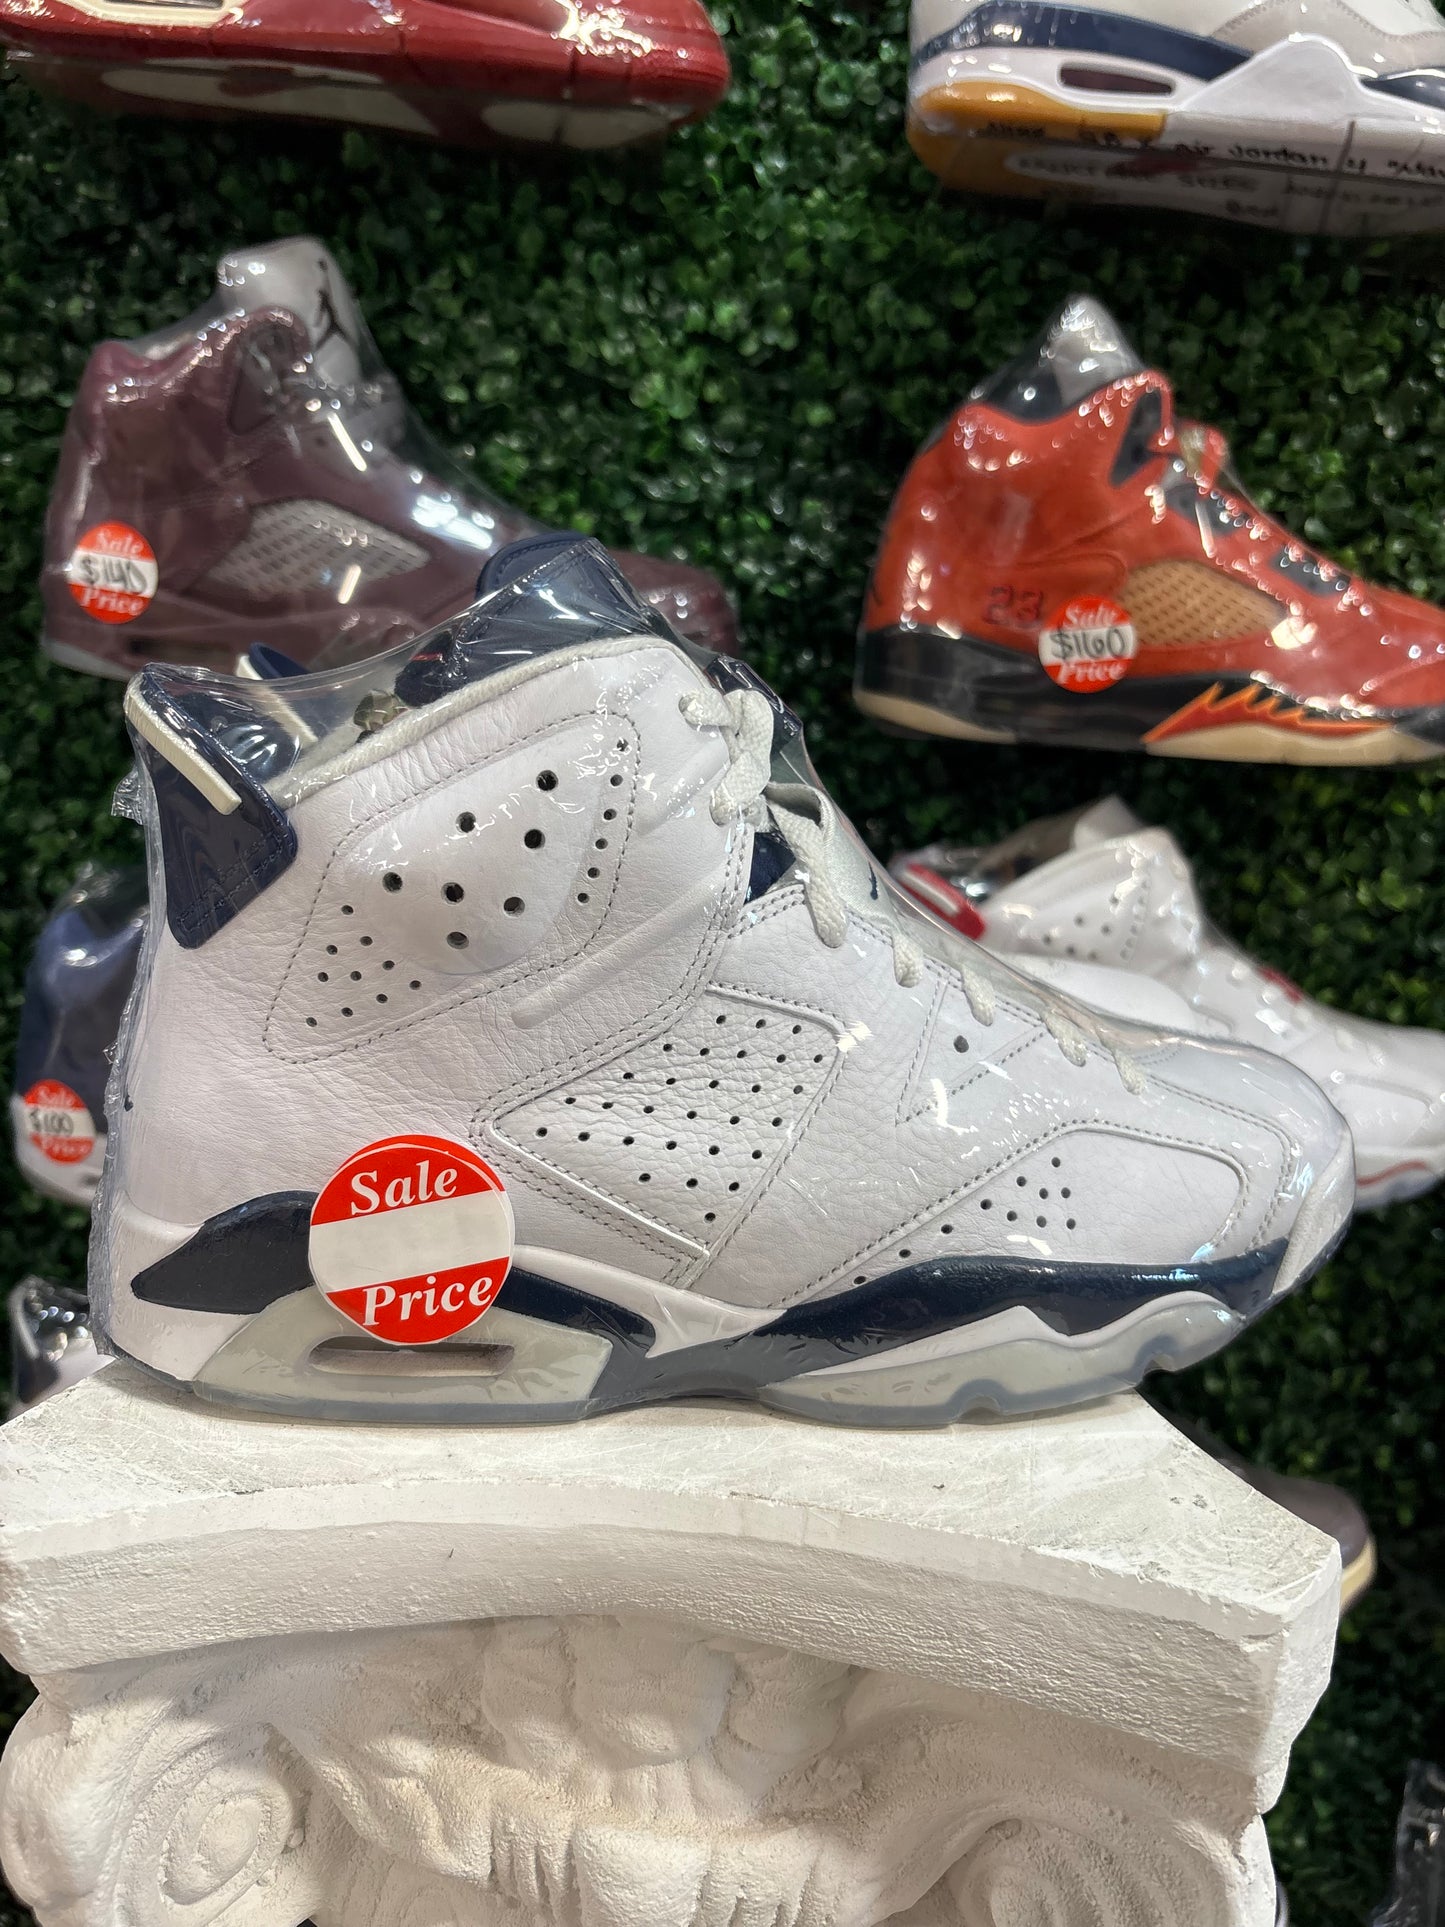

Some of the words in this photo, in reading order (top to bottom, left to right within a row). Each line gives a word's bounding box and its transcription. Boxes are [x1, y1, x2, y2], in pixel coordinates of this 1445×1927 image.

[1228, 144, 1328, 166] Jordan
[96, 529, 144, 558] Sale
[81, 587, 143, 616] Price
[984, 584, 1044, 625] 23
[1064, 602, 1116, 629] Sale
[1049, 624, 1126, 661] $160
[1056, 661, 1127, 685] Price
[37, 1085, 75, 1107] Sale
[351, 1160, 458, 1216] Sale
[362, 1275, 493, 1327] Price
